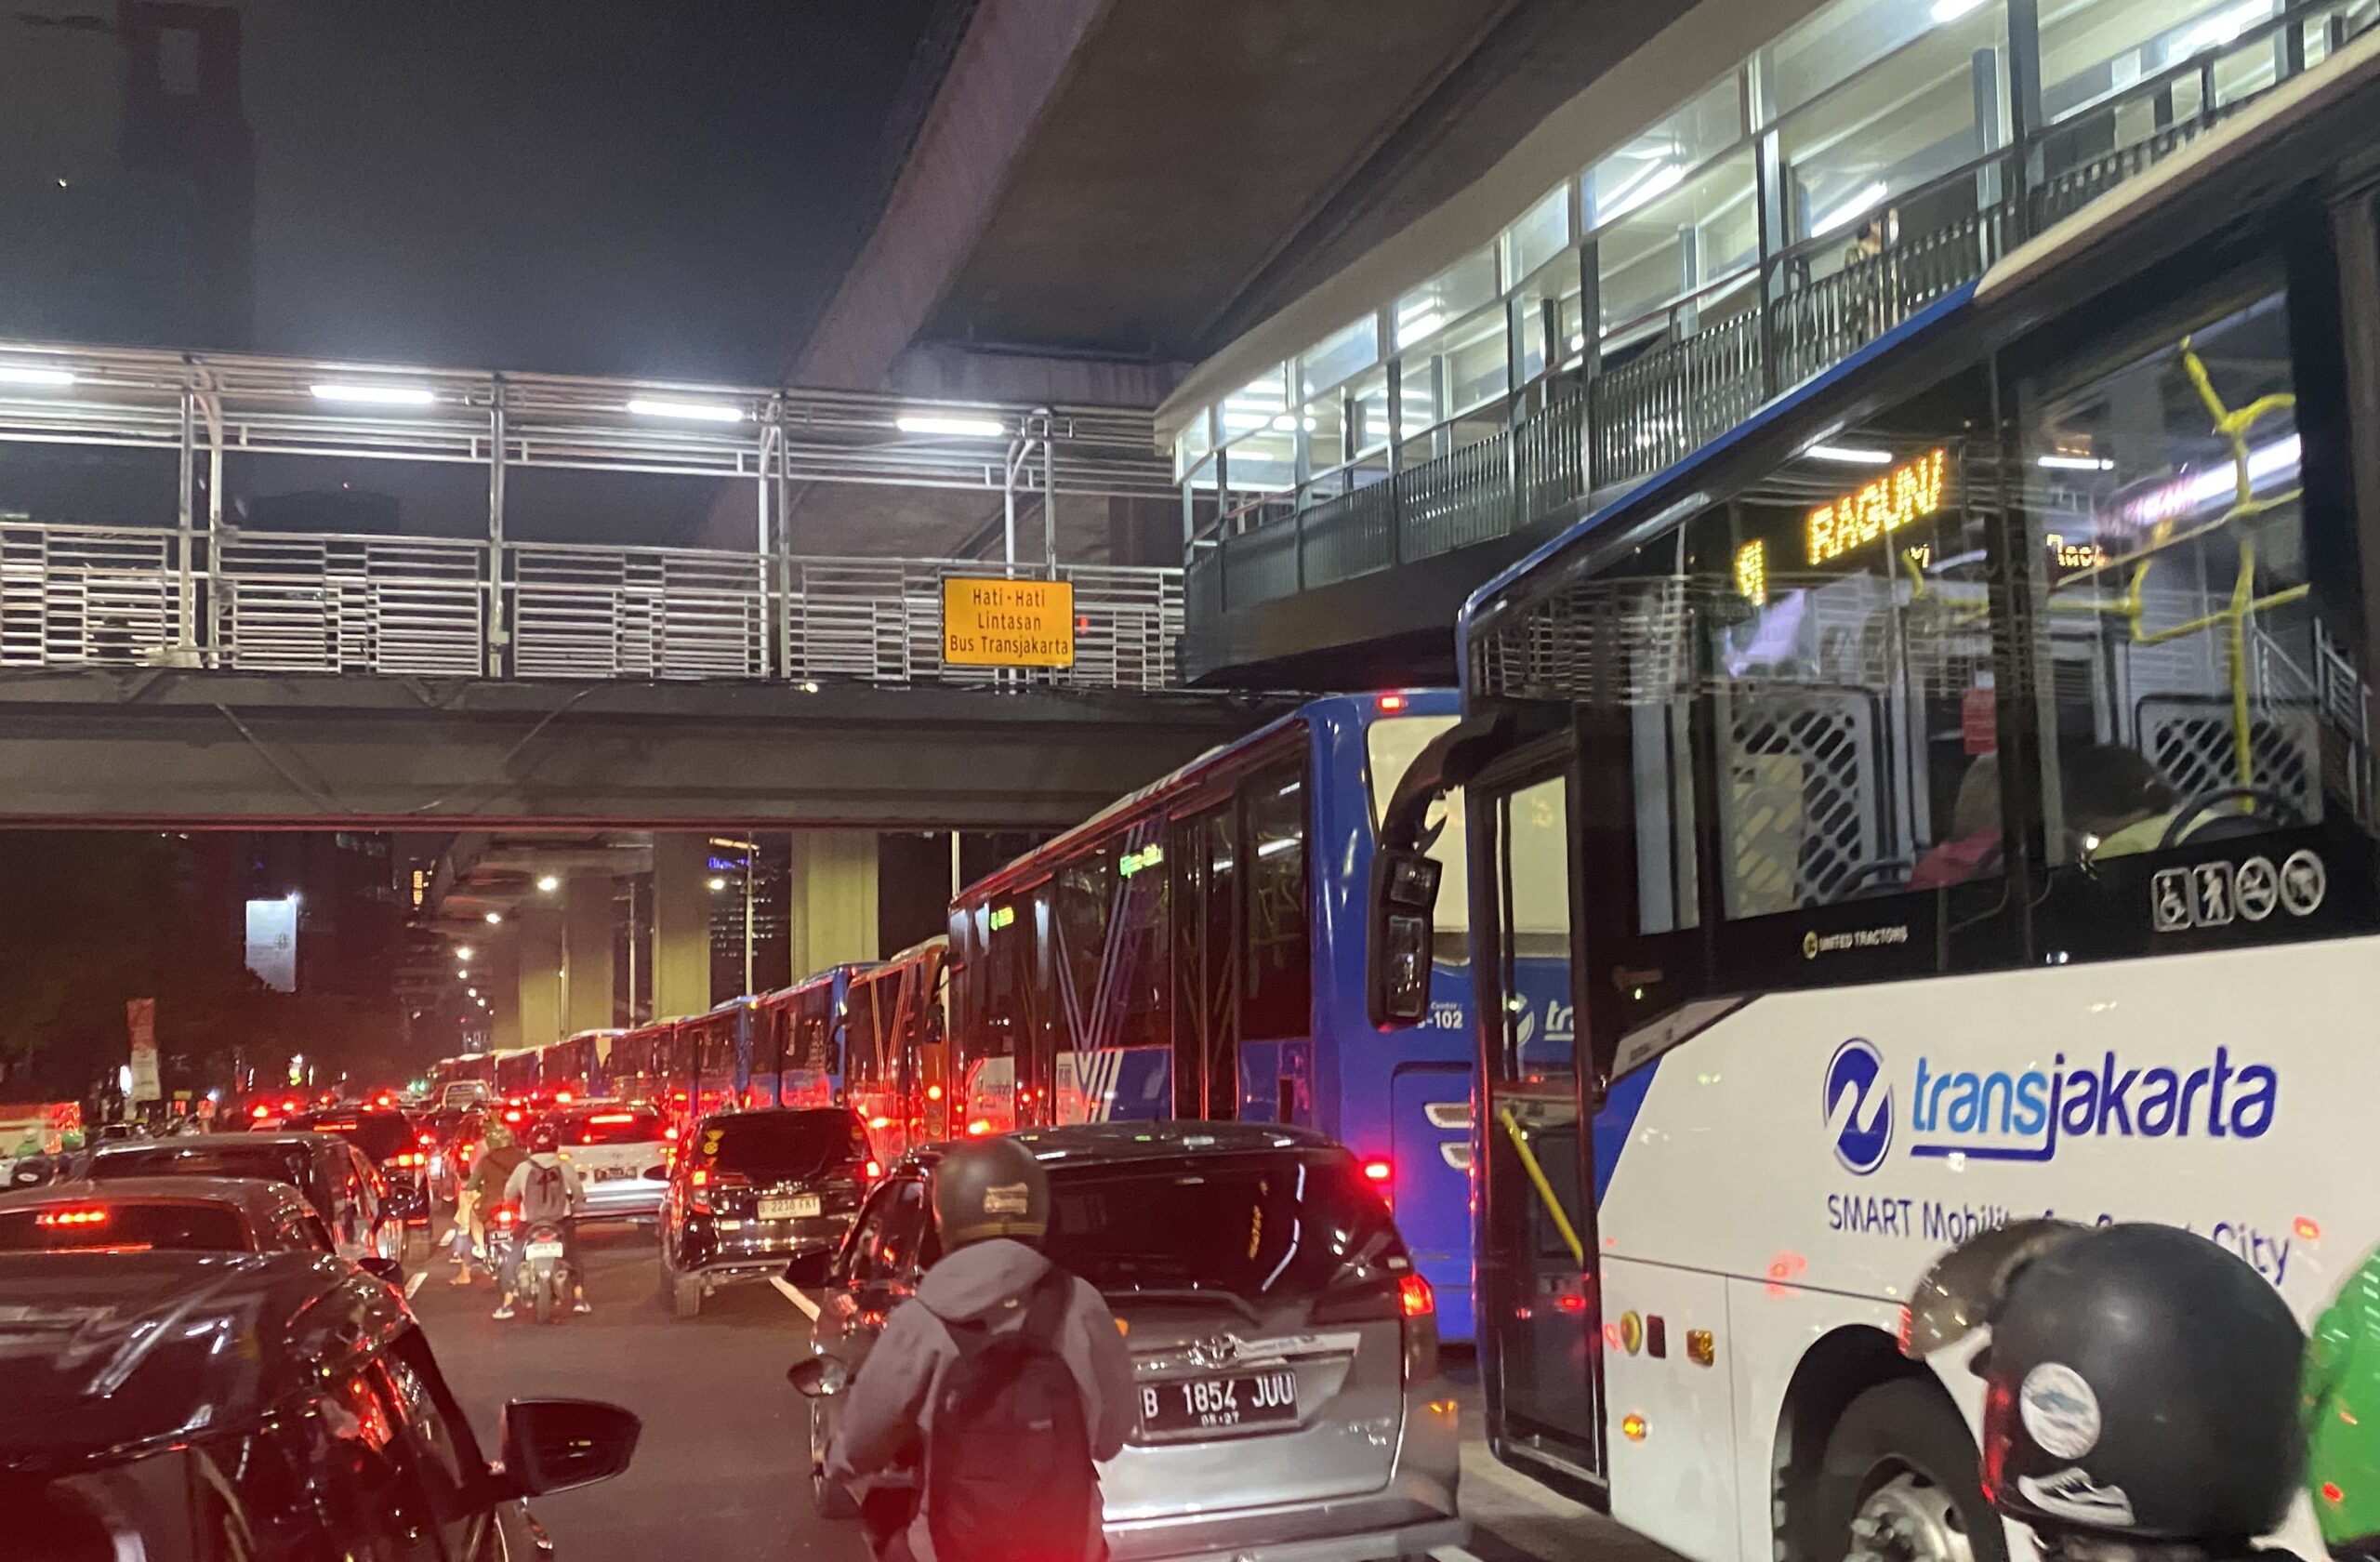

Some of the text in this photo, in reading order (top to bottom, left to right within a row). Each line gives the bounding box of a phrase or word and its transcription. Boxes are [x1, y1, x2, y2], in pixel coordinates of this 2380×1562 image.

[977, 611, 1041, 630] Lintasan
[949, 635, 1068, 658] Bus Transjakarta
[1818, 925, 1908, 951] UNITED TRACTORS
[1911, 1044, 2280, 1162] transjakarta
[1827, 1194, 1913, 1238] SMART
[1142, 1371, 1293, 1419] B 1854 JUU
